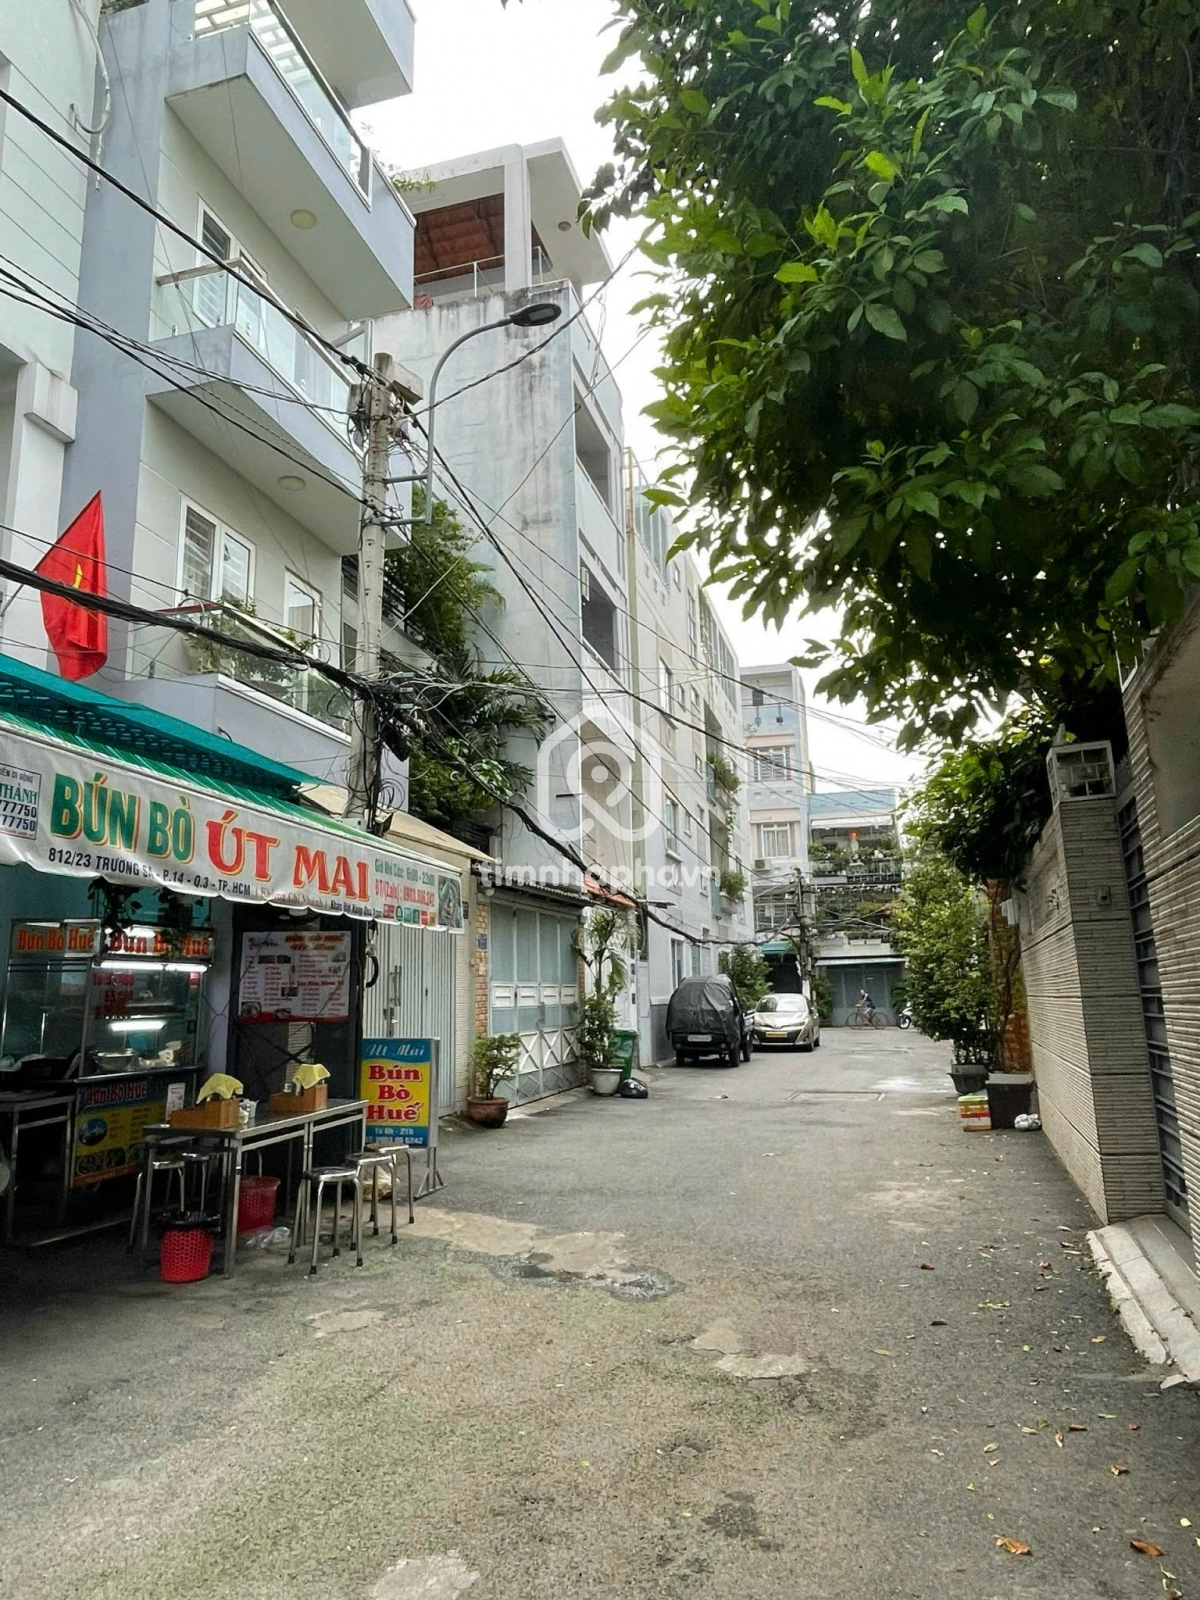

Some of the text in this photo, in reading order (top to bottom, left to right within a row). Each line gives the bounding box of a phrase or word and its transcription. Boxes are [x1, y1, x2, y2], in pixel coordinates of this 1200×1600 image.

[0, 799, 37, 819] 77750
[50, 772, 370, 901] BÚN BÒ ÚT MAI
[48, 847, 92, 868] 812/23
[96, 855, 140, 877] TRƯỜNG
[163, 869, 184, 885] P.14
[194, 874, 209, 888] Q.3
[218, 879, 230, 893] TP.
[232, 882, 251, 896] HCM
[368, 1064, 421, 1082] Bún
[377, 1083, 411, 1102] Bò
[366, 1101, 421, 1122] Huế
